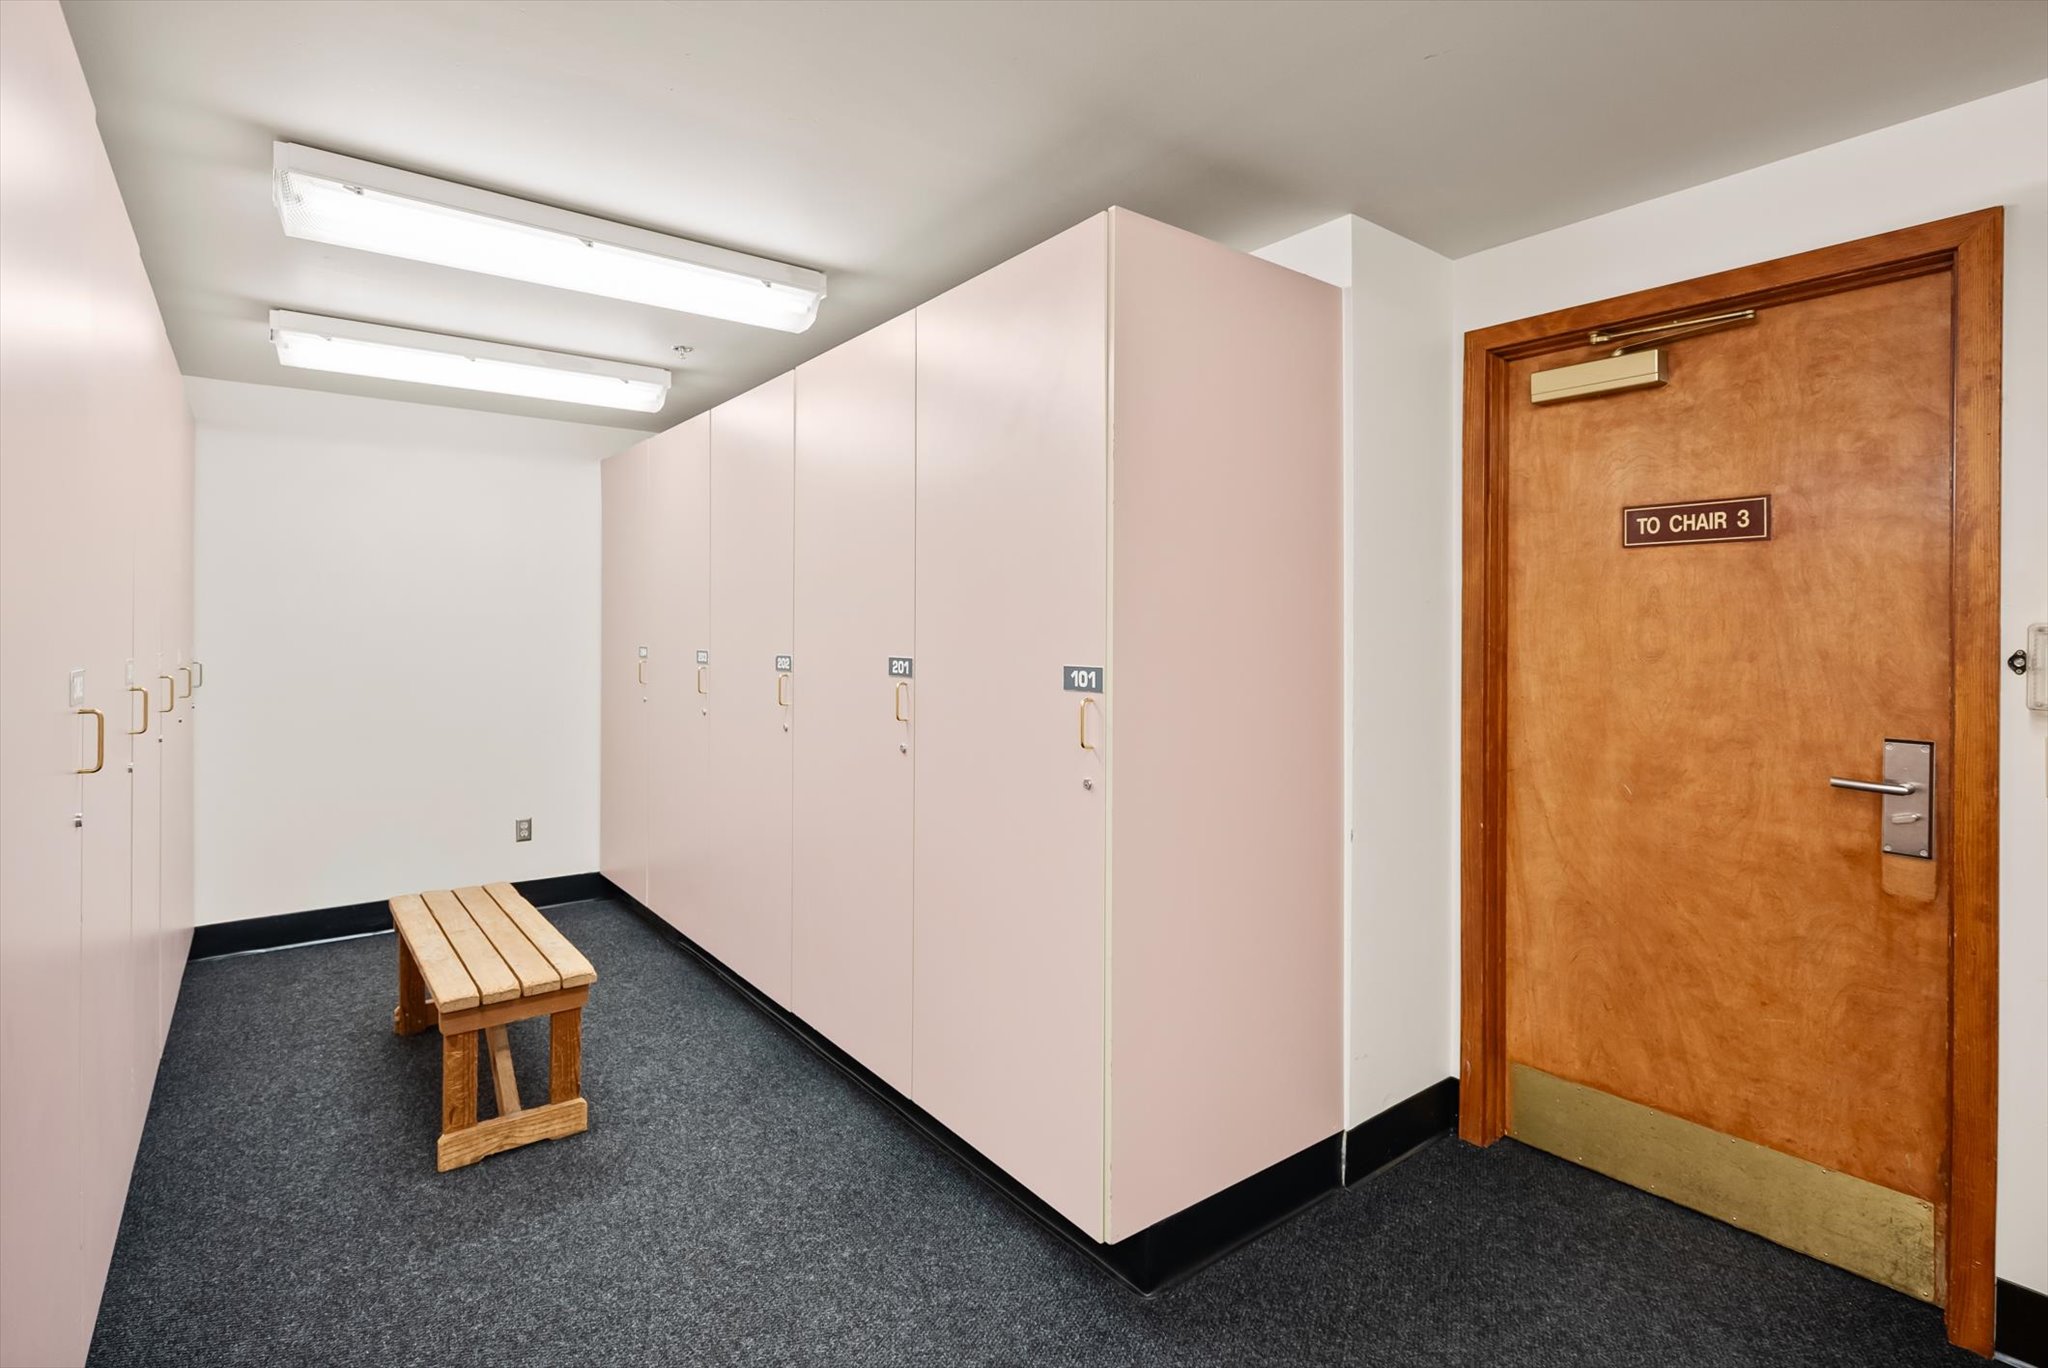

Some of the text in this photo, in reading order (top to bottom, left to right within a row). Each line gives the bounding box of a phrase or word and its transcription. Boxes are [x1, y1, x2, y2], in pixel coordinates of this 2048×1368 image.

[1636, 509, 1750, 535] TO CHAIR 3
[777, 657, 790, 669] 202
[892, 660, 909, 674] 201
[1070, 670, 1096, 688] 101
